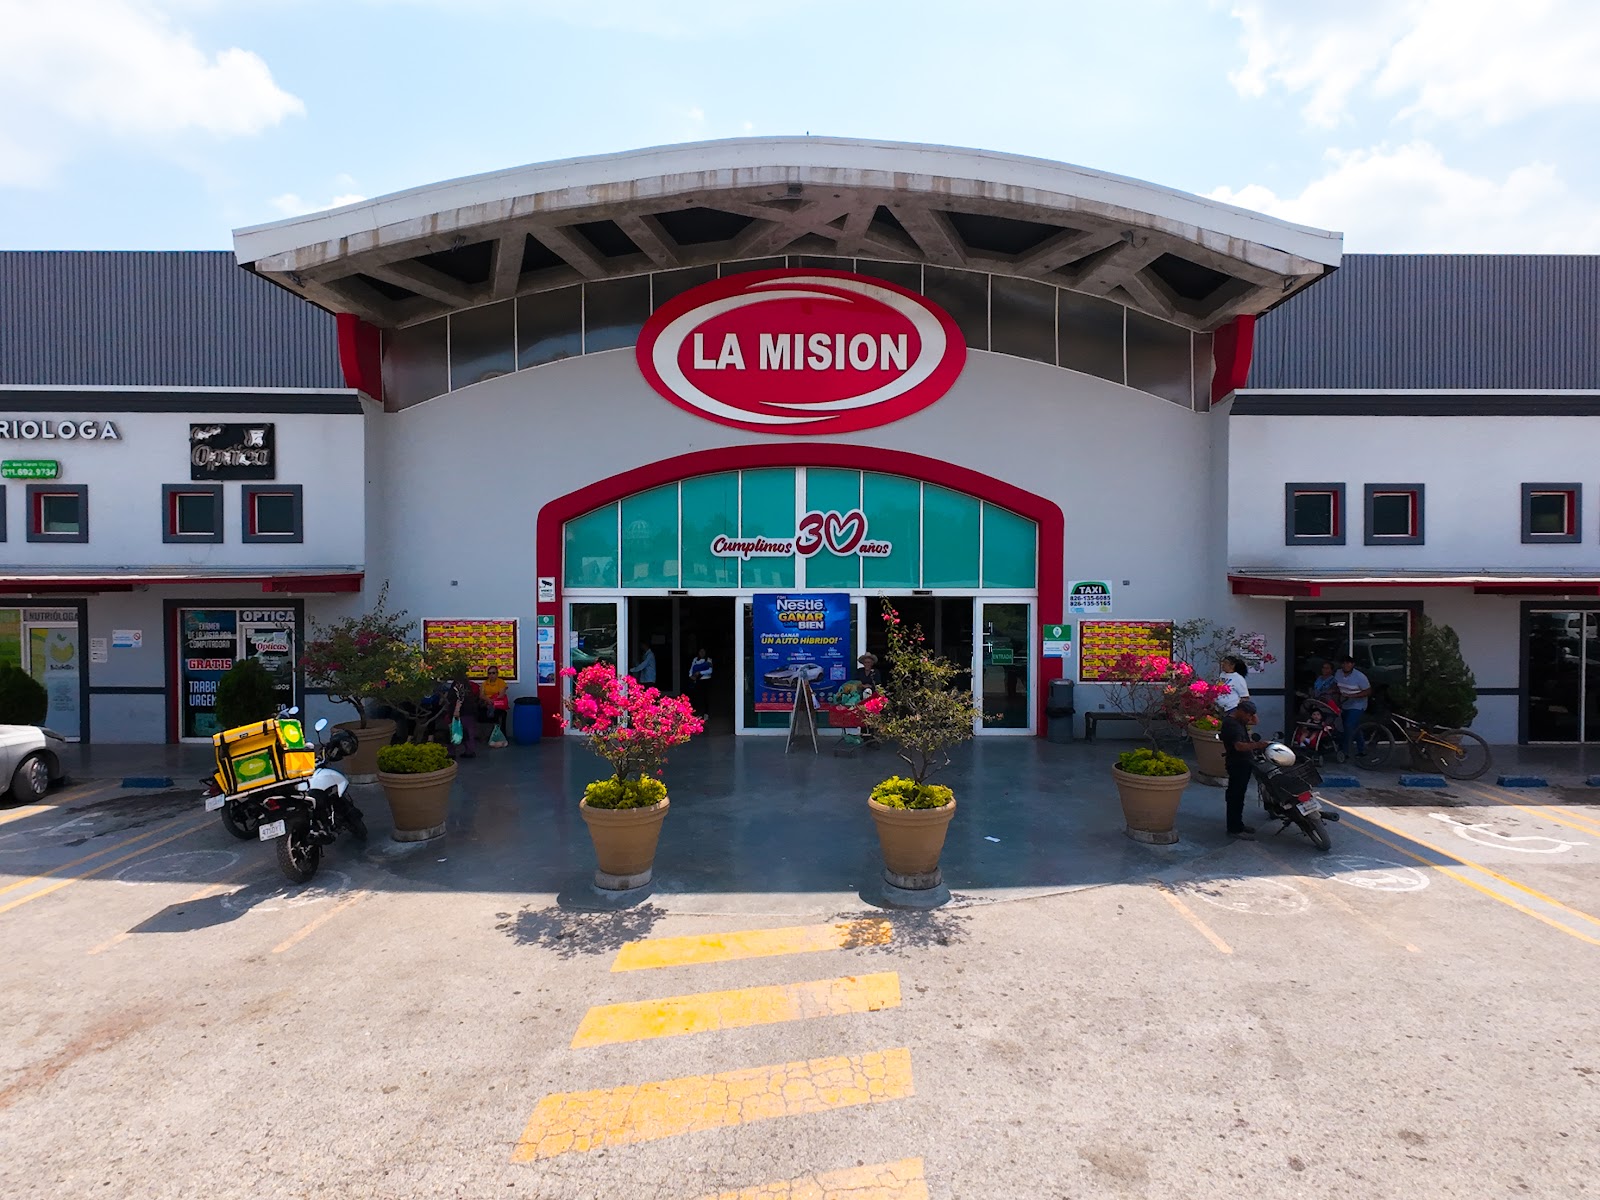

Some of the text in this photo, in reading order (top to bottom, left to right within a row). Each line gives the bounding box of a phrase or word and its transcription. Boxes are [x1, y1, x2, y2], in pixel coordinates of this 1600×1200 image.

[693, 333, 909, 370] LA MISION
[713, 537, 793, 558] Cumplimos
[859, 542, 889, 554] años
[1078, 586, 1103, 594] TAXI
[242, 611, 295, 621] OPTICA
[778, 612, 824, 621] GANAR
[798, 621, 824, 630] BIEN
[761, 637, 774, 645] UN
[775, 637, 799, 645] AUTO
[188, 658, 233, 670] GRATIS
